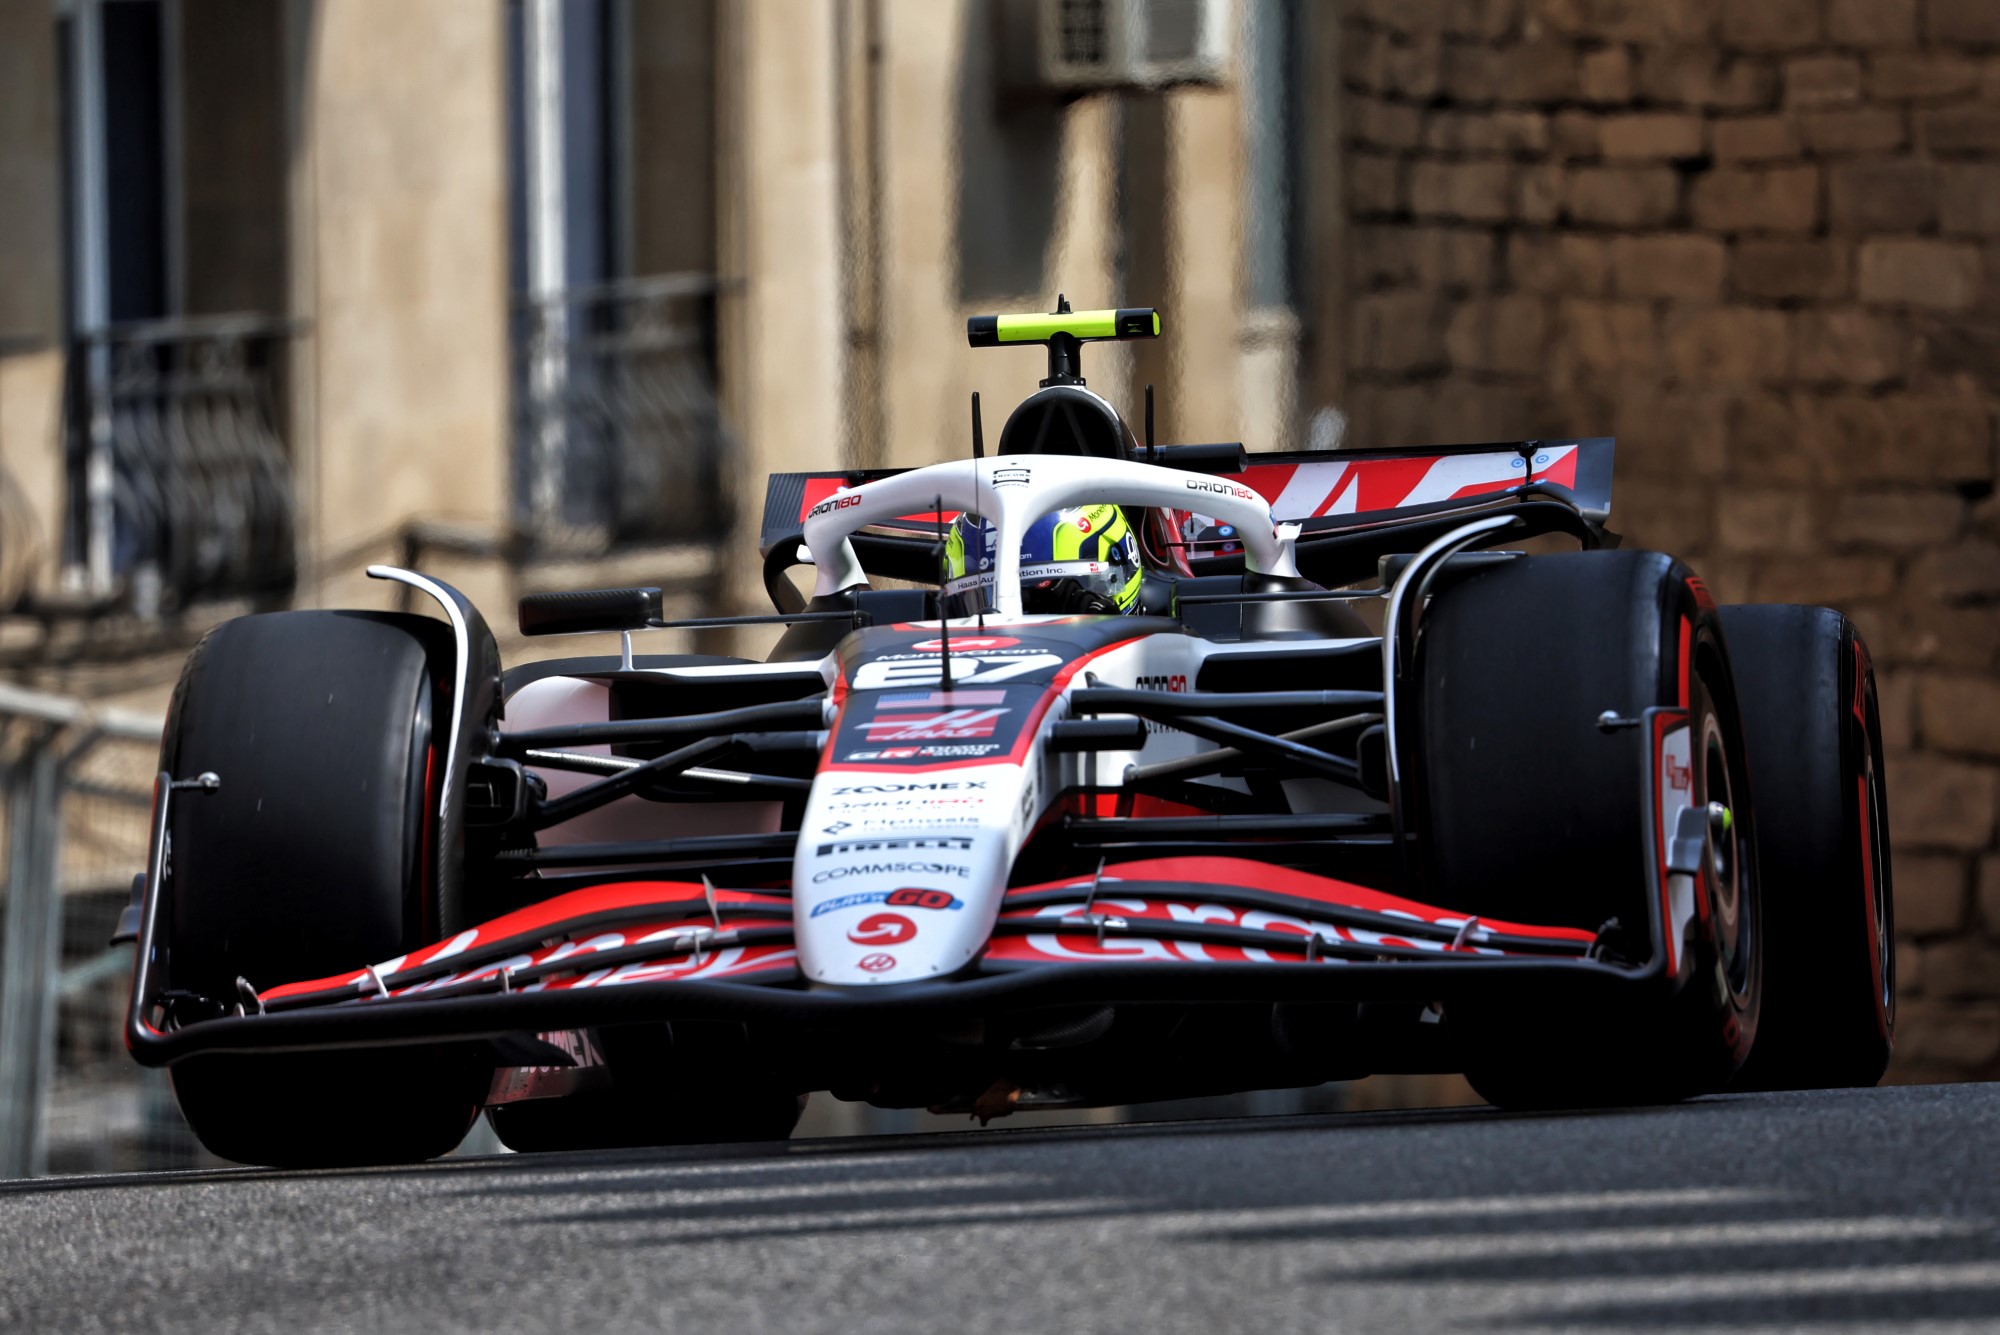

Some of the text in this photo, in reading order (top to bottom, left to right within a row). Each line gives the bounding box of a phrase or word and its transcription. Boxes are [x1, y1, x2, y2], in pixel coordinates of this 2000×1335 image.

[1186, 479, 1253, 500] ORION180
[957, 579, 978, 590] Haas
[1046, 567, 1066, 575] Inc.
[852, 653, 1063, 690] 87
[831, 781, 987, 796] ZOOMEX
[815, 836, 975, 858] PIRELLI
[812, 860, 972, 885] COMMSCOPE
[885, 887, 954, 909] GO
